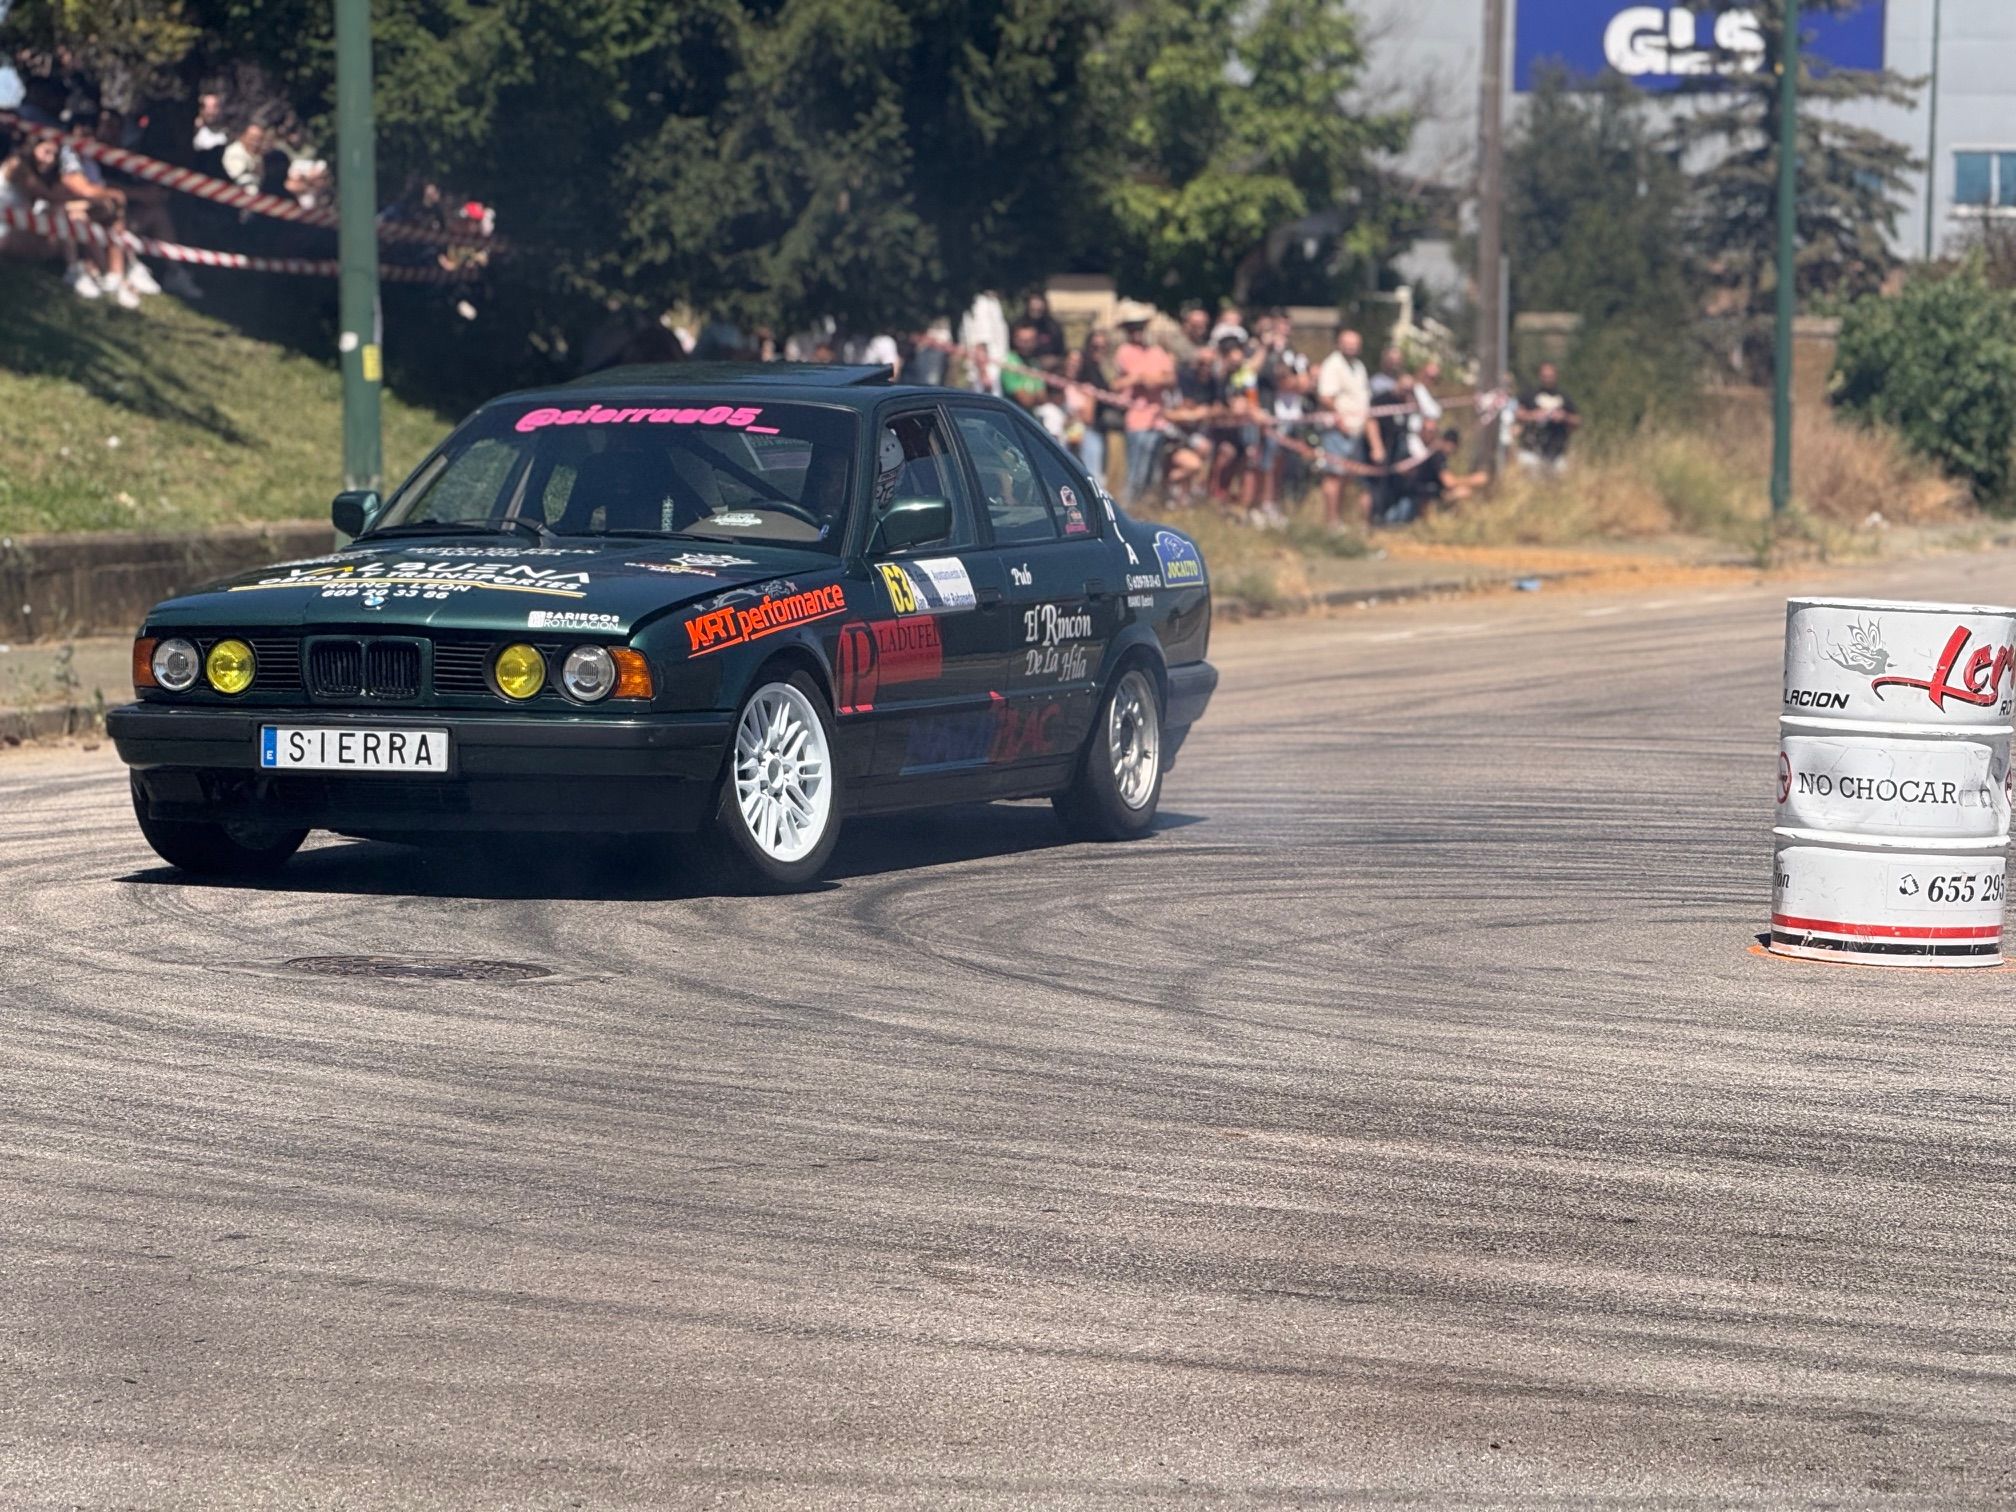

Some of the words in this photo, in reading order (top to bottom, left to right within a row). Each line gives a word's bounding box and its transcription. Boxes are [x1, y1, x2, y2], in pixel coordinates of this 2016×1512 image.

[1603, 5, 1766, 76] GLS
[258, 571, 355, 585] OBRAS
[362, 571, 382, 579] Y
[385, 571, 582, 591] TRANSPORTES
[290, 562, 590, 584] VALBUENA
[1011, 563, 1032, 586] Pub
[1167, 560, 1199, 579] JOCAUTO
[322, 589, 358, 597] 609
[393, 589, 419, 598] 33
[881, 564, 917, 613] 63
[546, 611, 620, 623] SARIEGOS
[684, 606, 737, 651] KRT
[736, 583, 846, 642] performance
[1024, 604, 1041, 642] El
[1041, 604, 1092, 646] Rincón
[1025, 649, 1042, 675] De
[1042, 647, 1058, 673] La
[266, 750, 274, 760] E
[289, 731, 432, 765] SIERRA
[1798, 772, 1832, 797] NO
[1839, 776, 1957, 805] CHOCAR
[1928, 875, 1977, 903] 655
